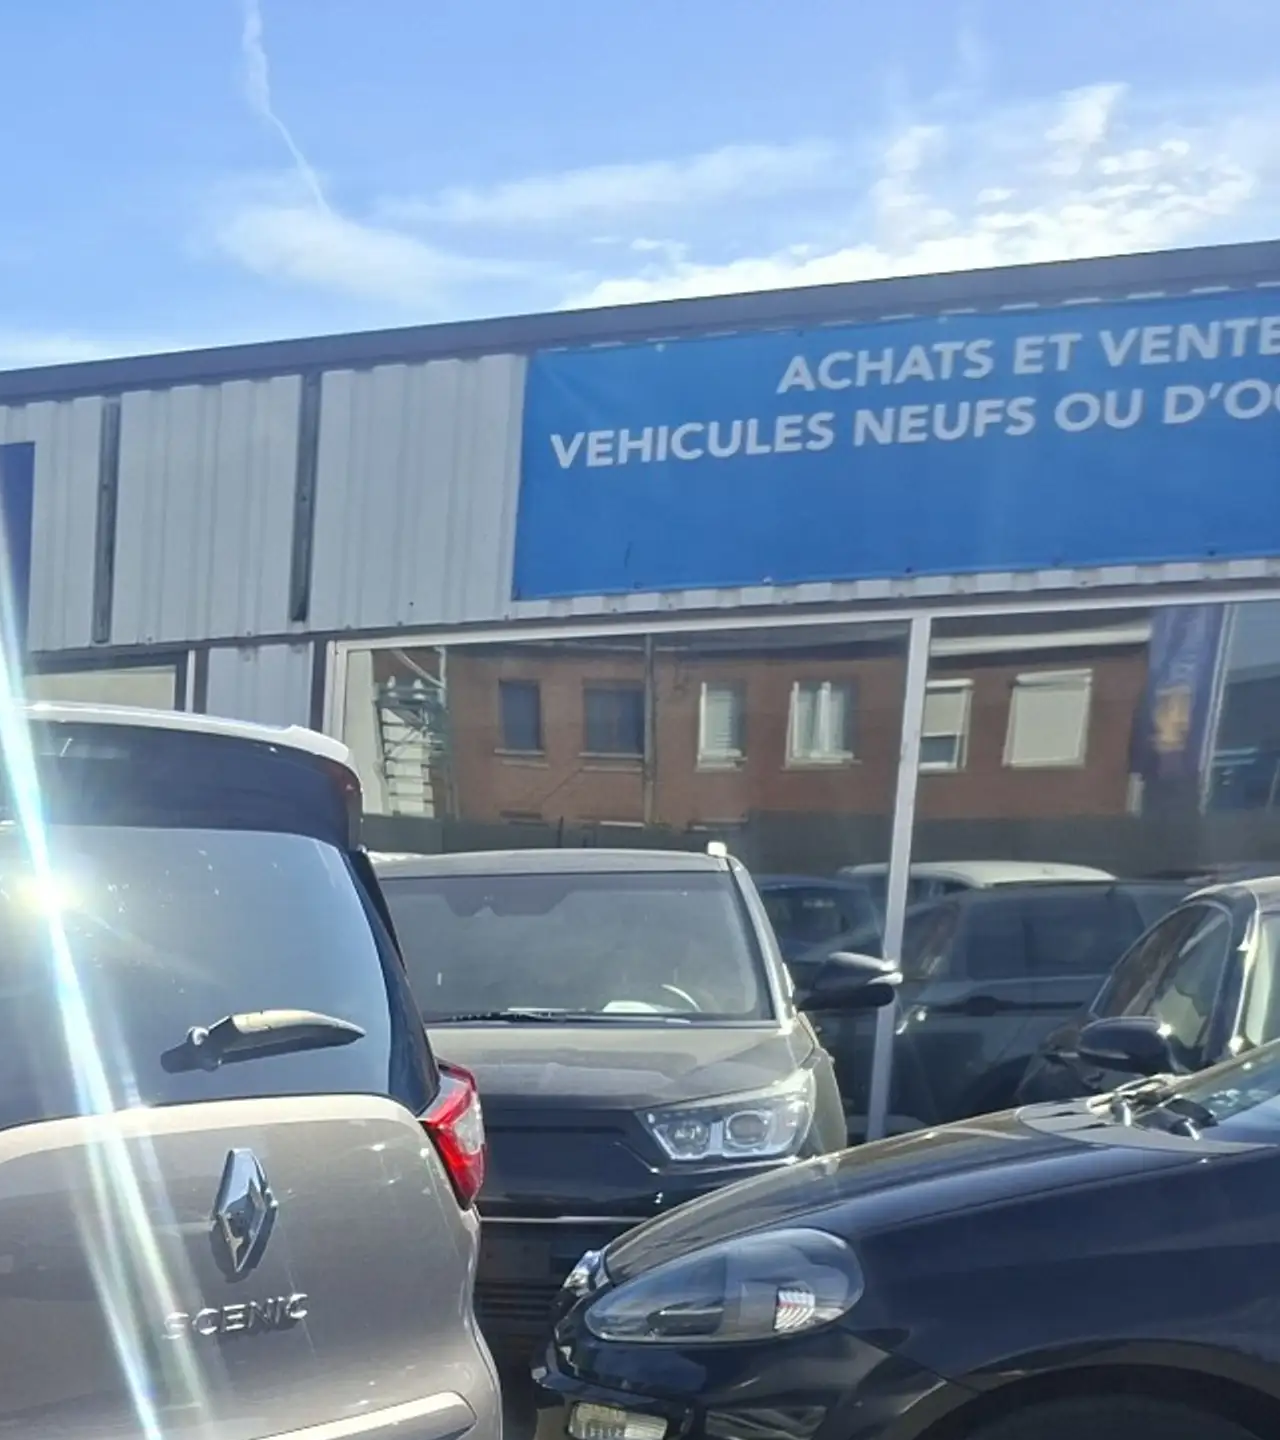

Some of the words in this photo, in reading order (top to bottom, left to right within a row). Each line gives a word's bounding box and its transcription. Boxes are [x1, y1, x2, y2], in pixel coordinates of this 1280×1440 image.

[776, 339, 996, 394] ACHATS
[1013, 332, 1082, 375] ET
[550, 412, 834, 469] VEHICULES
[852, 396, 1036, 447] NEUFS
[1054, 388, 1144, 432] OU
